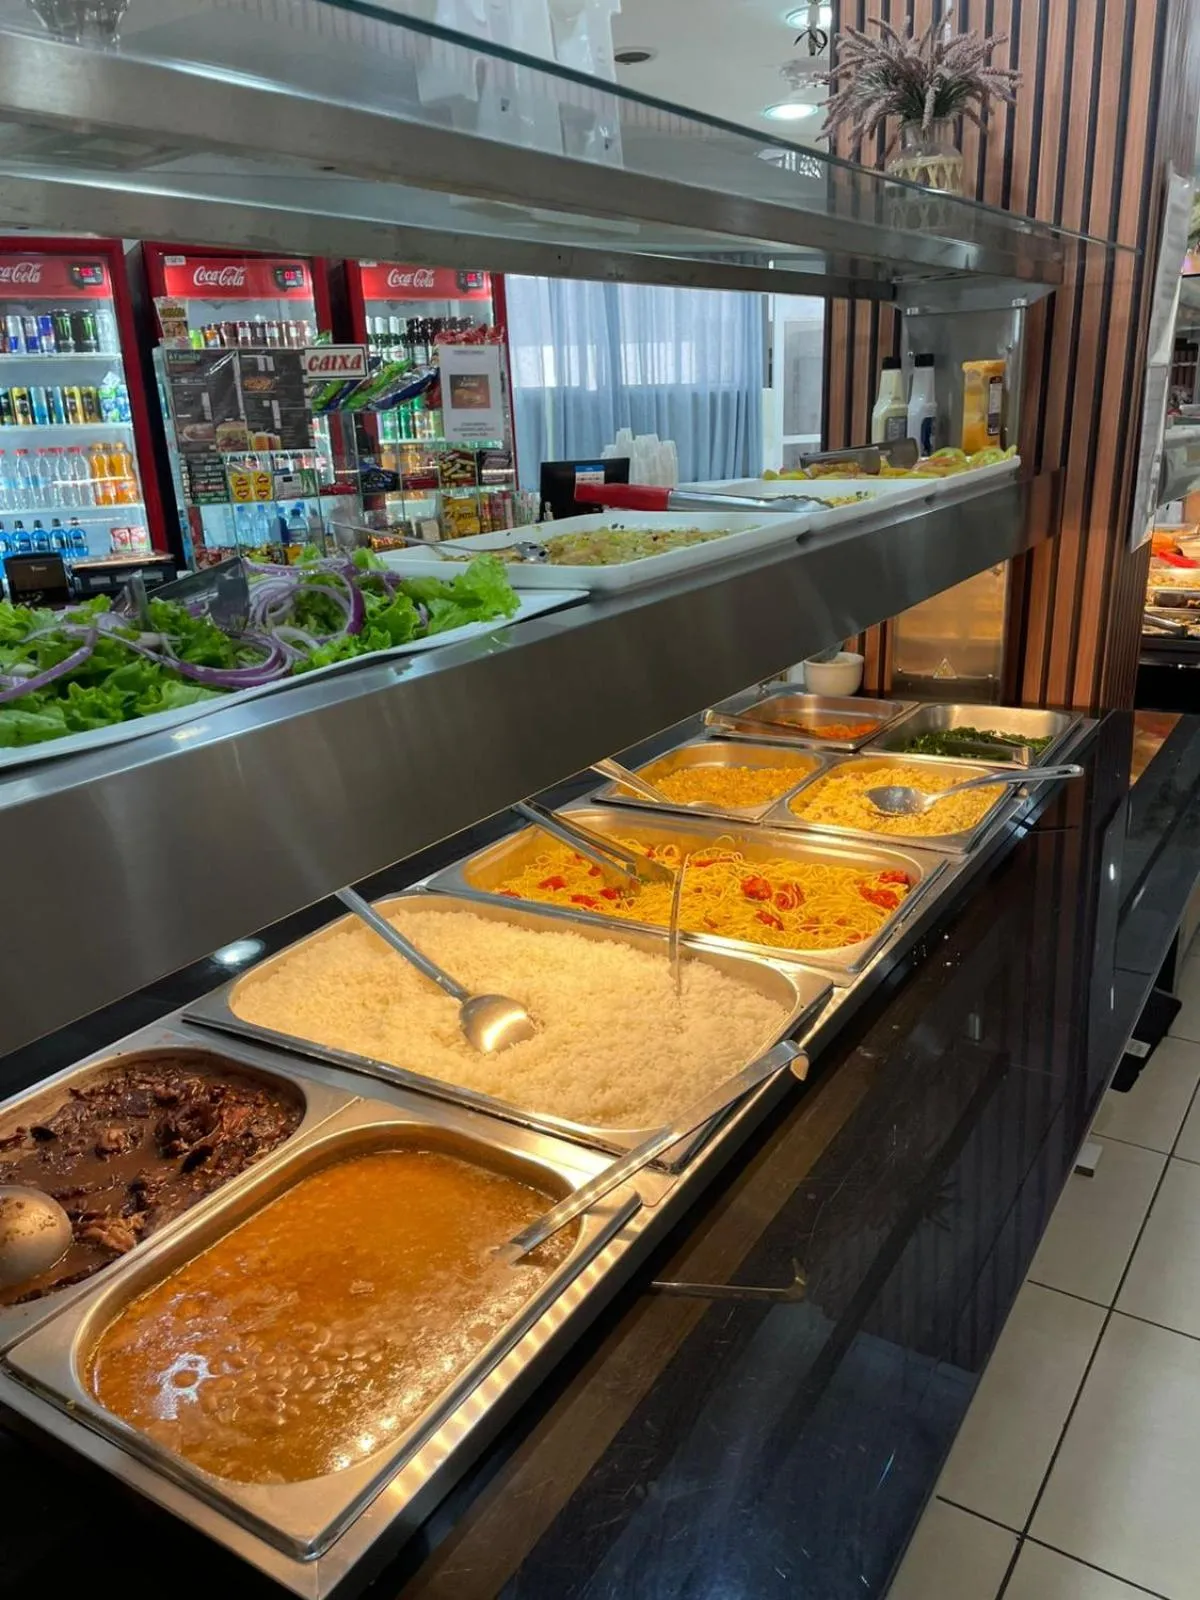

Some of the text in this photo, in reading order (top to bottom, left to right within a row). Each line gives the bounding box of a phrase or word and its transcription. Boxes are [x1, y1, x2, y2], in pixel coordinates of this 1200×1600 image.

[192, 265, 248, 288] Coca-Cola
[386, 268, 436, 288] Coca-Cola
[308, 353, 363, 373] CAIXA
